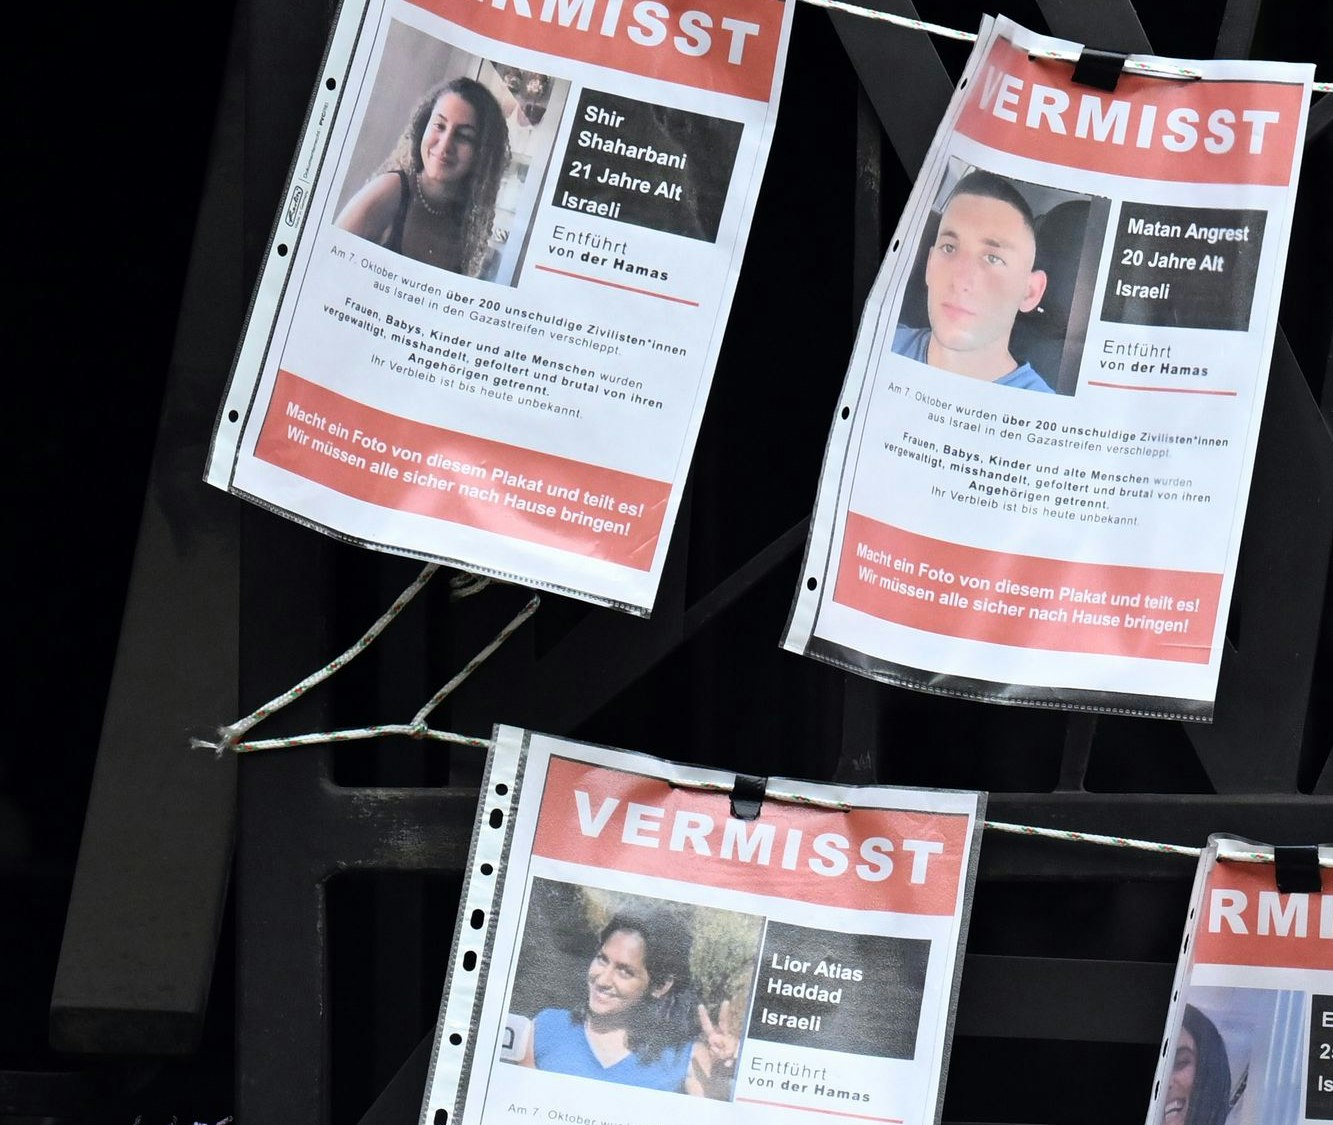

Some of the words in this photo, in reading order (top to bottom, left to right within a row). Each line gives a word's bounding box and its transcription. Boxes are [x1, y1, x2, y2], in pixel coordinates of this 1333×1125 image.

[475, 0, 760, 65] MISST
[583, 104, 625, 128] Shir
[977, 64, 1280, 155] VERMISST
[576, 129, 687, 170] Shaharbani
[567, 159, 592, 180] 21
[595, 166, 651, 194] Jahre
[652, 180, 683, 202] Alt
[560, 189, 621, 219] Israeli
[551, 223, 627, 256] Entführt
[1126, 216, 1182, 238] Matan
[1183, 221, 1250, 245] Angrest
[547, 244, 575, 259] von
[579, 250, 608, 266] der
[612, 256, 668, 281] Hamas
[1119, 247, 1144, 267] 20
[1146, 250, 1197, 271] Jahre
[1197, 253, 1225, 272] Alt
[1114, 278, 1170, 300] Israeli
[855, 541, 892, 568] Macht
[892, 556, 915, 575] ein
[917, 561, 955, 584] Foto
[958, 574, 991, 591] von
[993, 577, 1055, 600] diesem
[1058, 585, 1108, 605] Plakat
[1109, 592, 1142, 607] und
[1143, 594, 1174, 611] teilt
[1175, 597, 1200, 613] es!
[574, 790, 944, 884] VERMISST
[770, 951, 812, 974] Lior
[812, 959, 863, 982] Atias
[765, 976, 843, 1004] Haddad
[760, 1006, 822, 1032] Israeli
